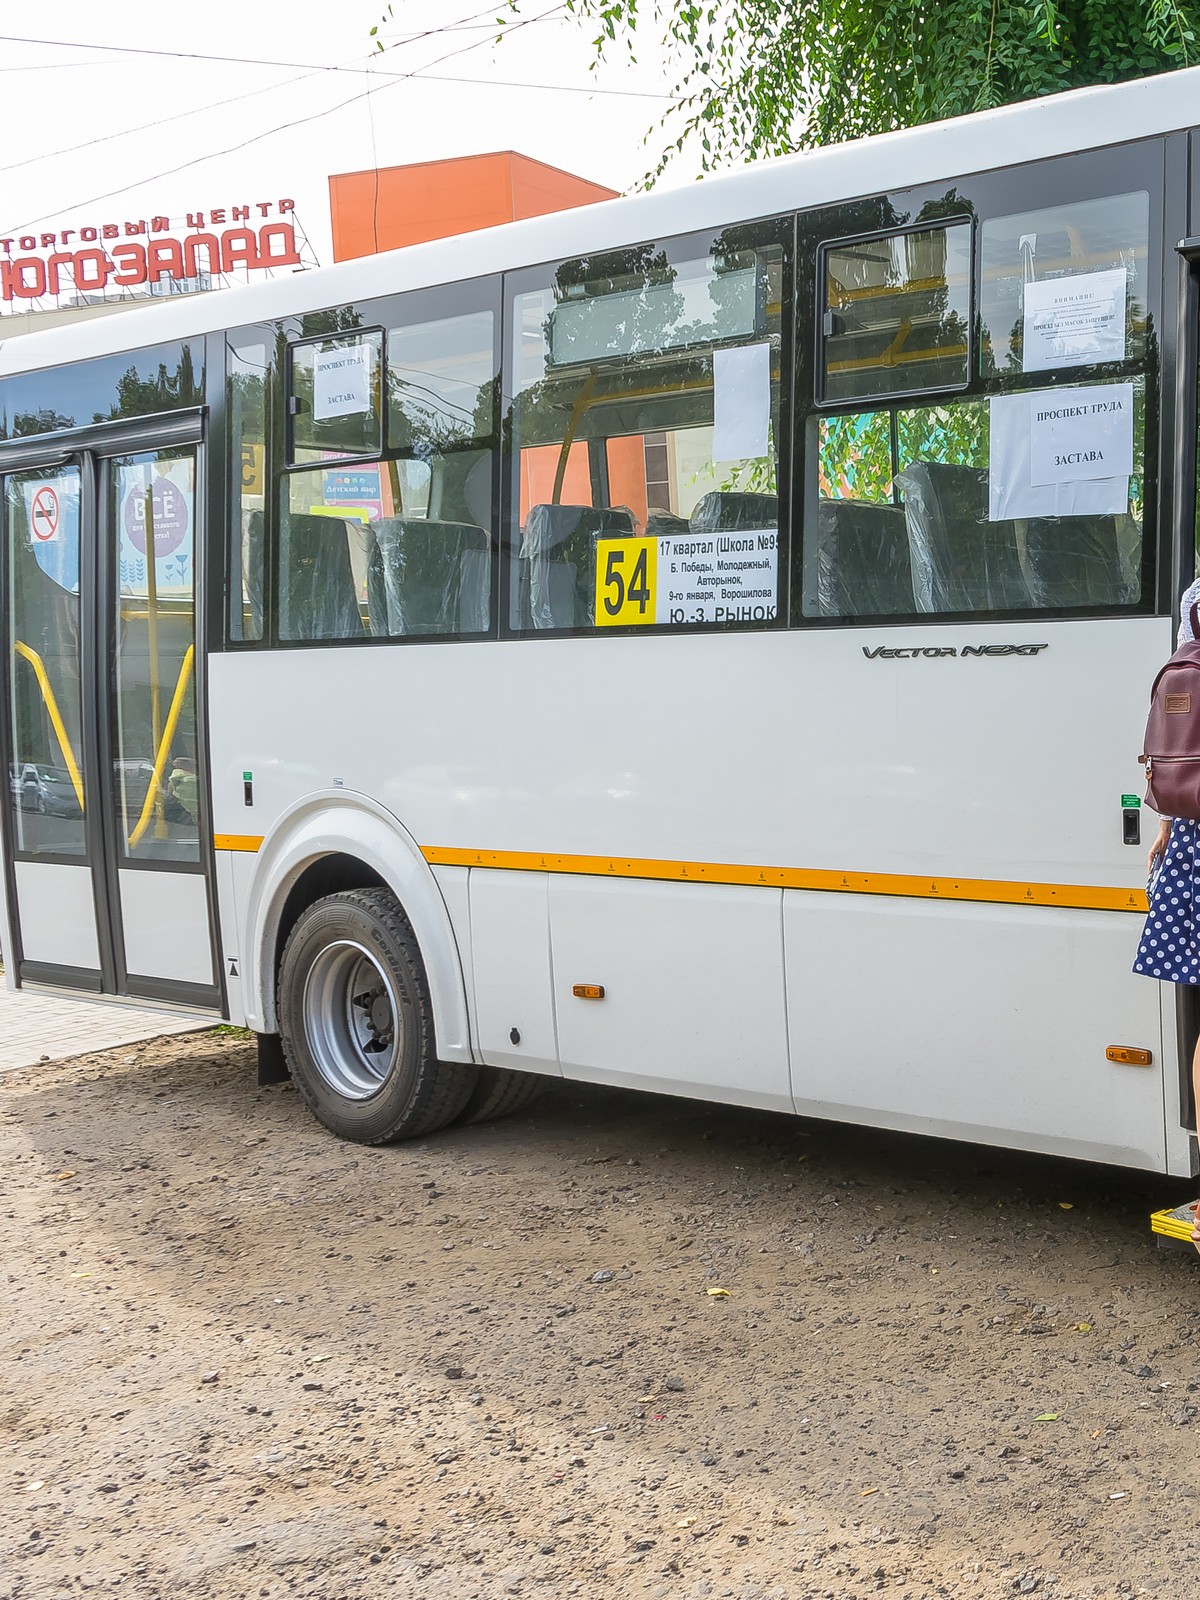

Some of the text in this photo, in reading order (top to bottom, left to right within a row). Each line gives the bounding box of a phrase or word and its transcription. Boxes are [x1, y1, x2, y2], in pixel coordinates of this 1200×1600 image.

[0, 199, 295, 253] ТОРГОВЫЙ ЦЕНТР
[1, 223, 300, 301] ЮГО-ЗАПАД
[328, 393, 355, 404] ЗАСТАВА
[1037, 401, 1123, 422] ПРОСПЕКТ ТРУДА
[1054, 450, 1104, 466] ЗАСТАВА
[134, 491, 175, 520] ВСЁ
[660, 541, 671, 556] 17
[673, 541, 713, 558] квартал
[716, 537, 754, 556] (Школа
[671, 558, 772, 573] Б. Победы, Молодежный,
[604, 548, 650, 616] 54
[697, 575, 743, 587] Авторынок,
[669, 588, 772, 602] 9-го января, Ворошилова
[715, 605, 777, 622] РЫНОК
[960, 643, 1049, 657] NEXT
